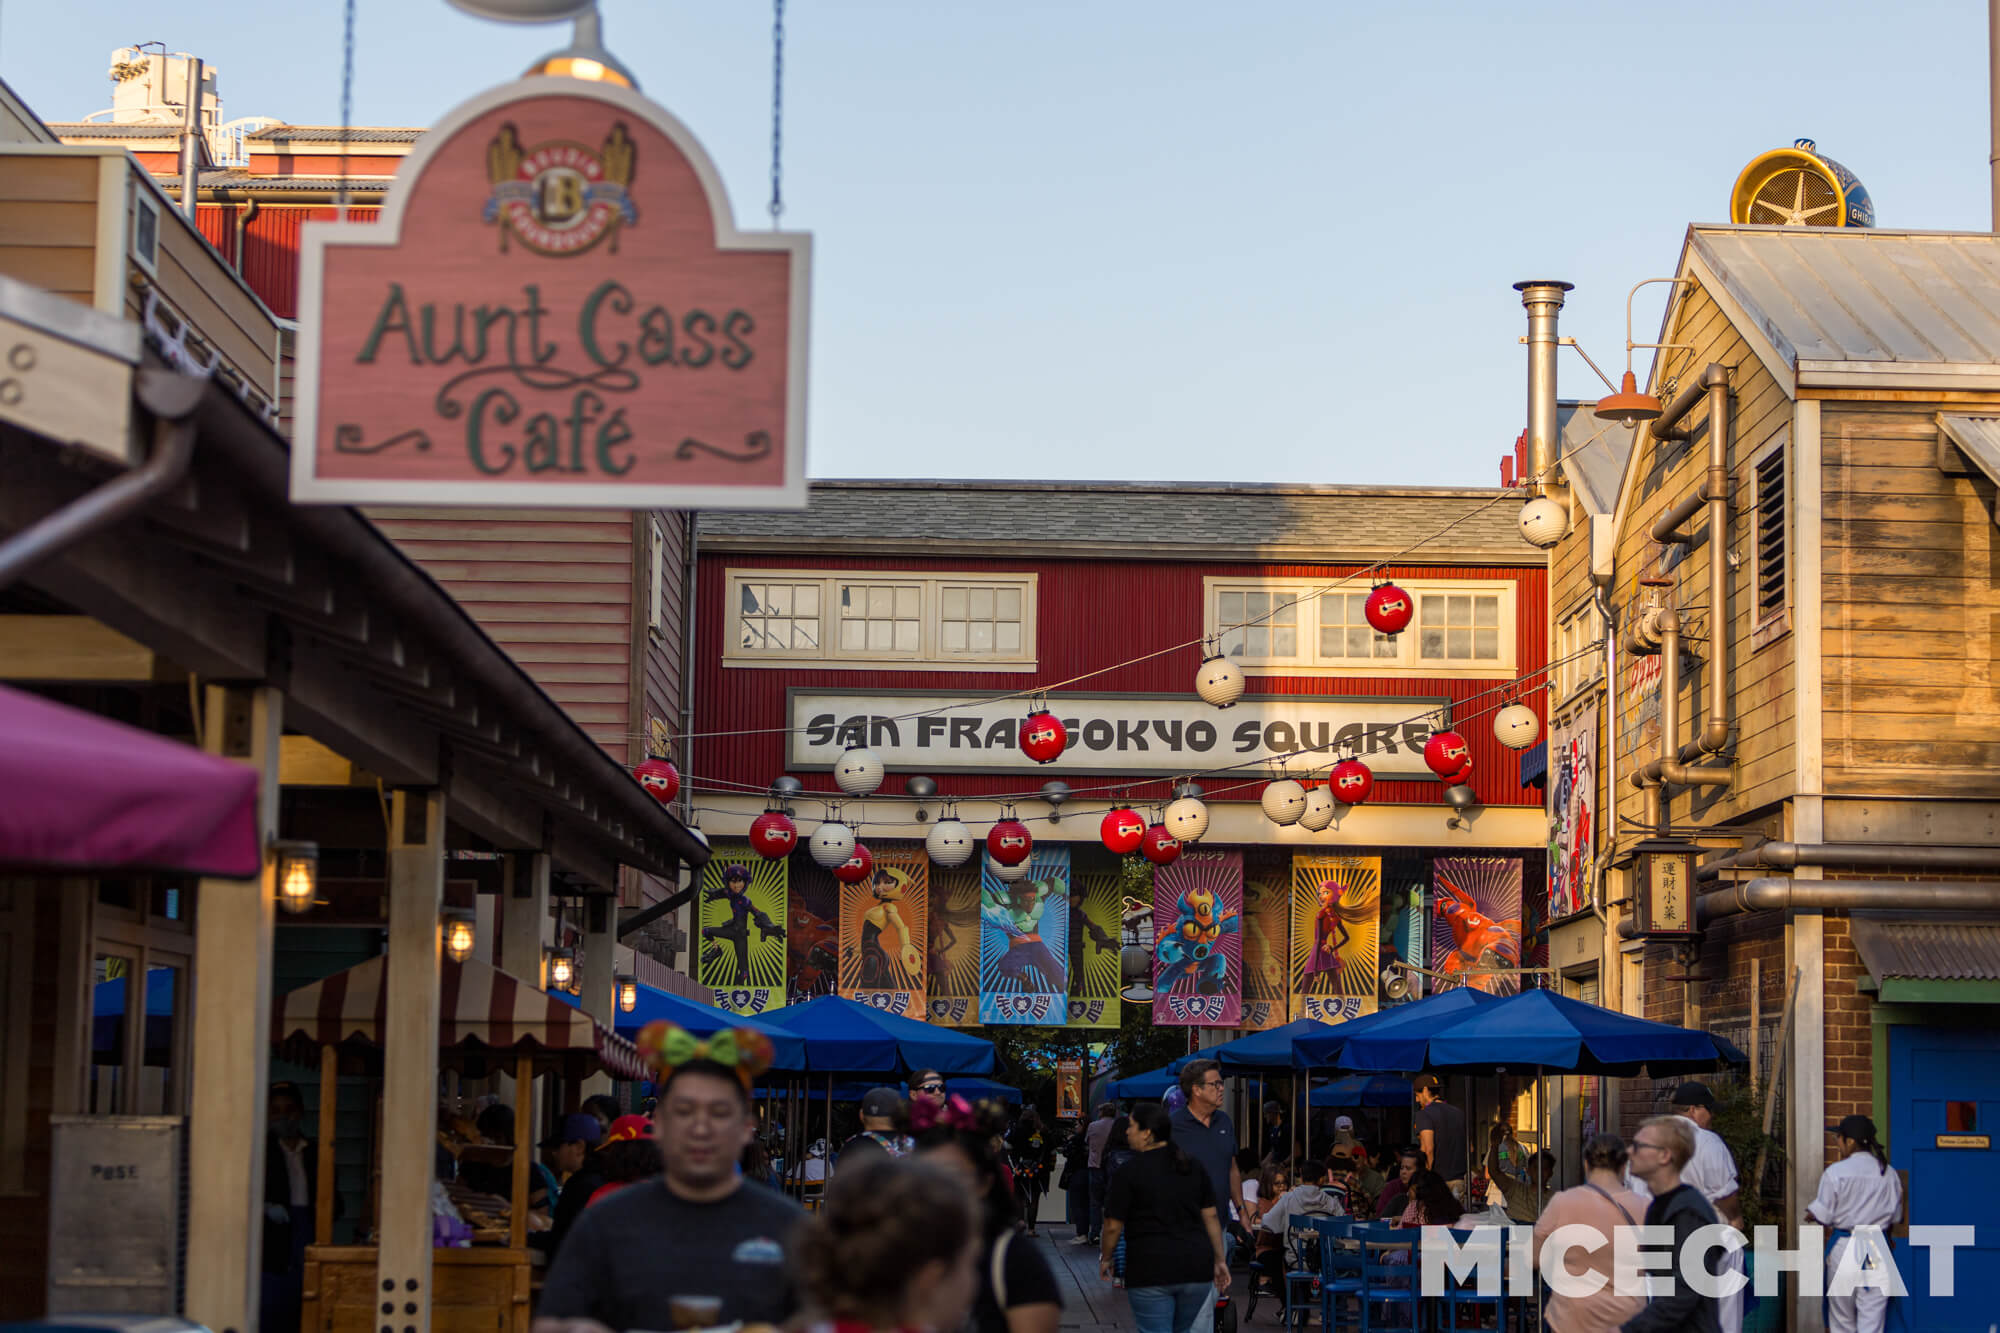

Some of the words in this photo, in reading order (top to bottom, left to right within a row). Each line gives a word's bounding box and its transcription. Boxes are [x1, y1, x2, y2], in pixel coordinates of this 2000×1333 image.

[1851, 208, 1873, 225] GHIRA
[355, 283, 559, 366] Aunt
[578, 280, 755, 370] Cass
[466, 387, 637, 476] Café
[807, 714, 901, 748] SAN
[917, 716, 1217, 752] FRASOKYO
[1232, 720, 1431, 755] SQUARE
[1180, 850, 1225, 861] レッドジラ
